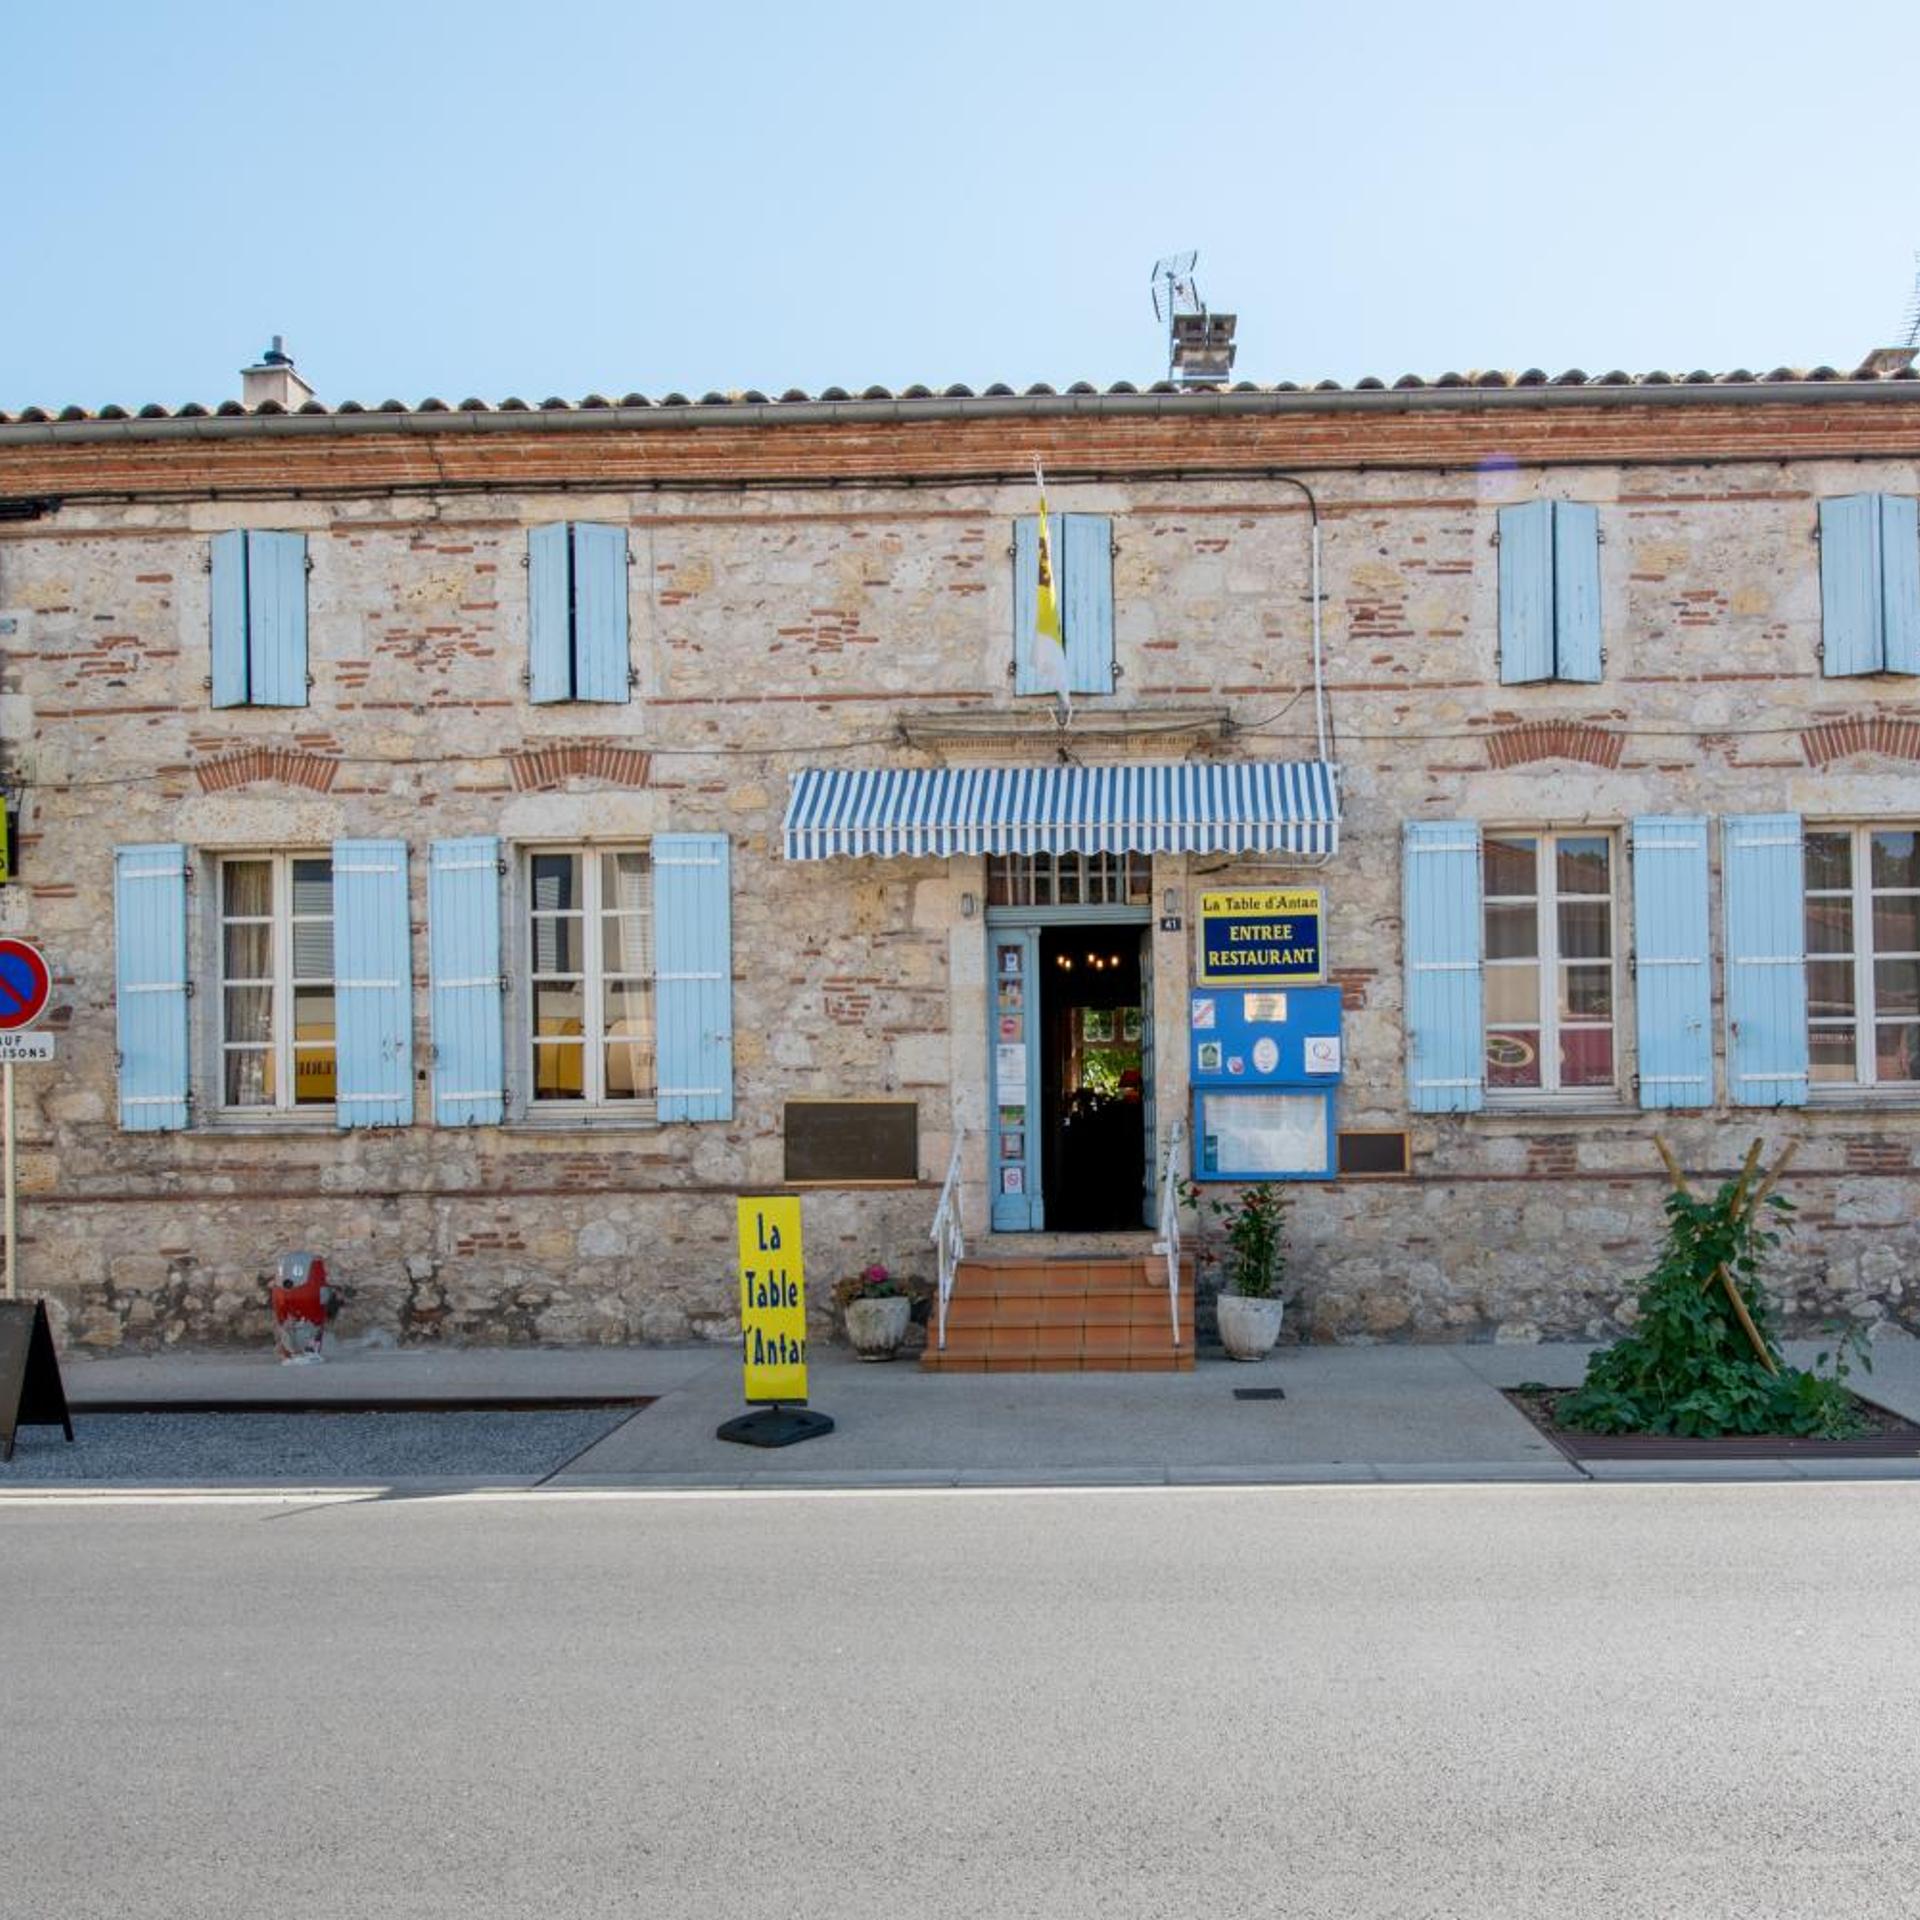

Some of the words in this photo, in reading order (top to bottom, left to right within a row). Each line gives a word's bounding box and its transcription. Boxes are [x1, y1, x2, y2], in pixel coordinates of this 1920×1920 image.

[1203, 898, 1220, 911] La
[1225, 896, 1261, 910] Table
[1265, 895, 1318, 910] d'Antan
[1229, 924, 1293, 941] ENTREE
[1208, 948, 1315, 967] RESTAURANT
[0, 1047, 47, 1058] ISONS
[757, 1212, 781, 1251] La
[745, 1269, 798, 1308] Table
